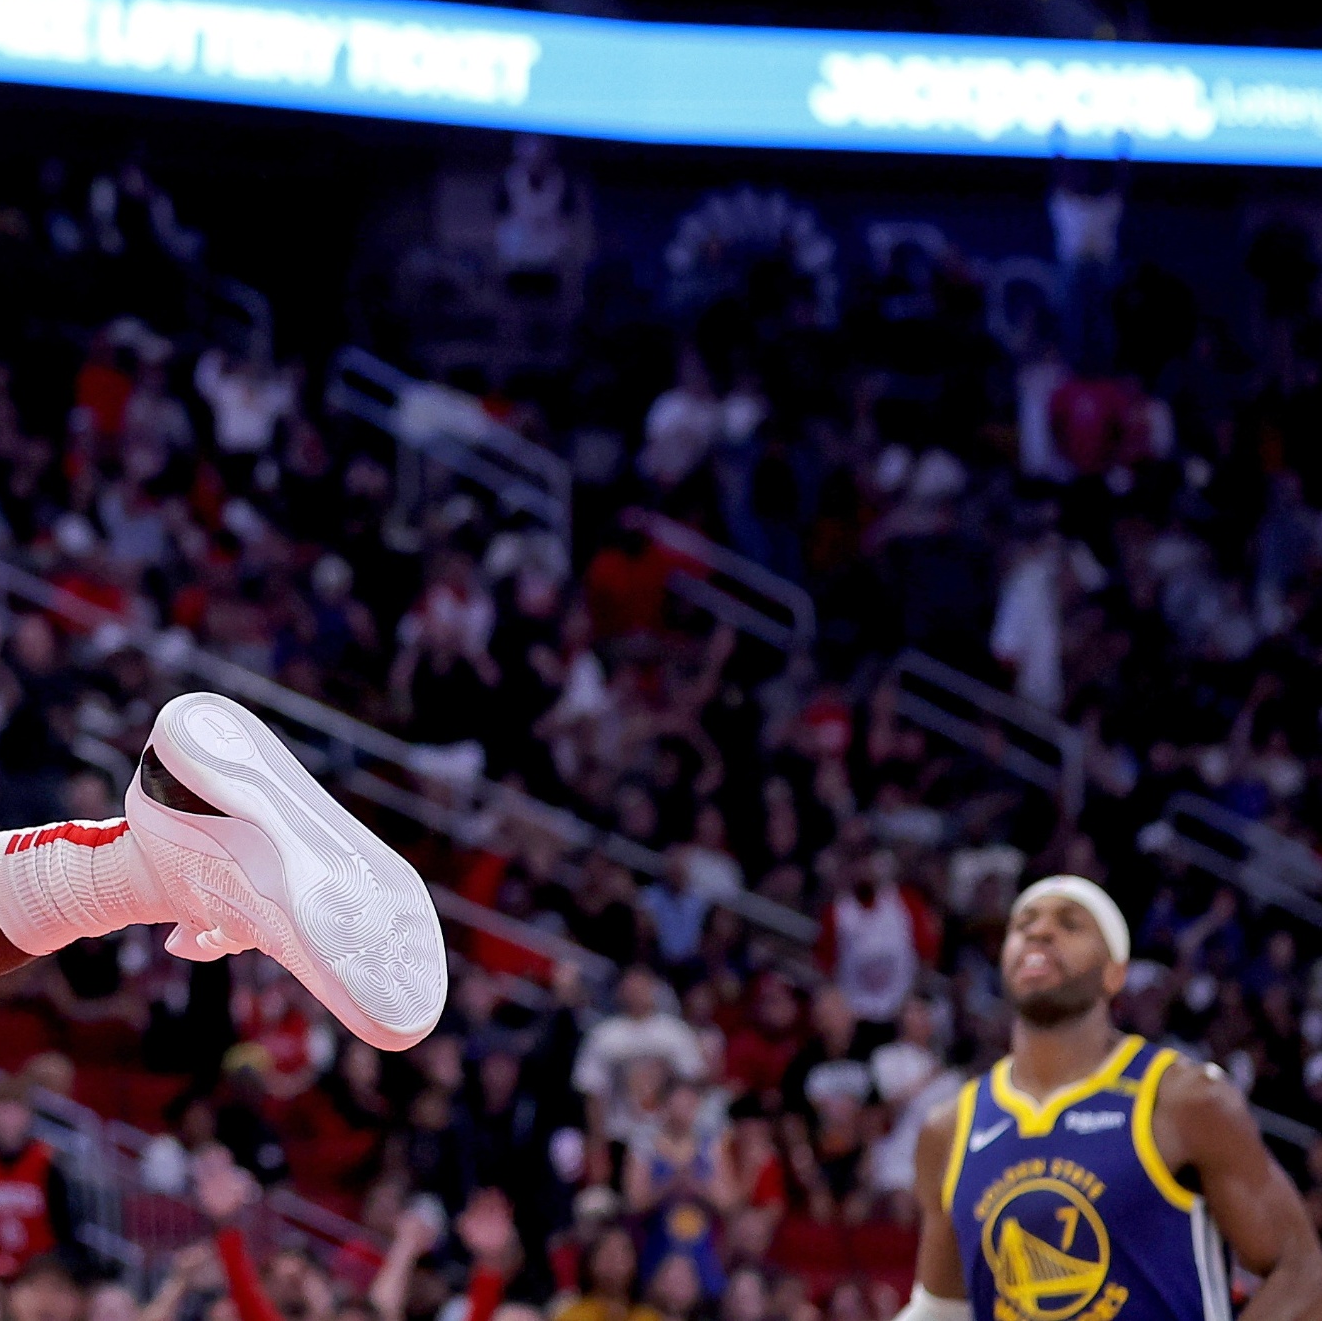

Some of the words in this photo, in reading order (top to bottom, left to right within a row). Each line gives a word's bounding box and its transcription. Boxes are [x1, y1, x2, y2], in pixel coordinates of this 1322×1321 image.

[345, 17, 542, 107] TICKET
[1050, 1157, 1107, 1201] STATE
[1055, 1206, 1080, 1252] 7
